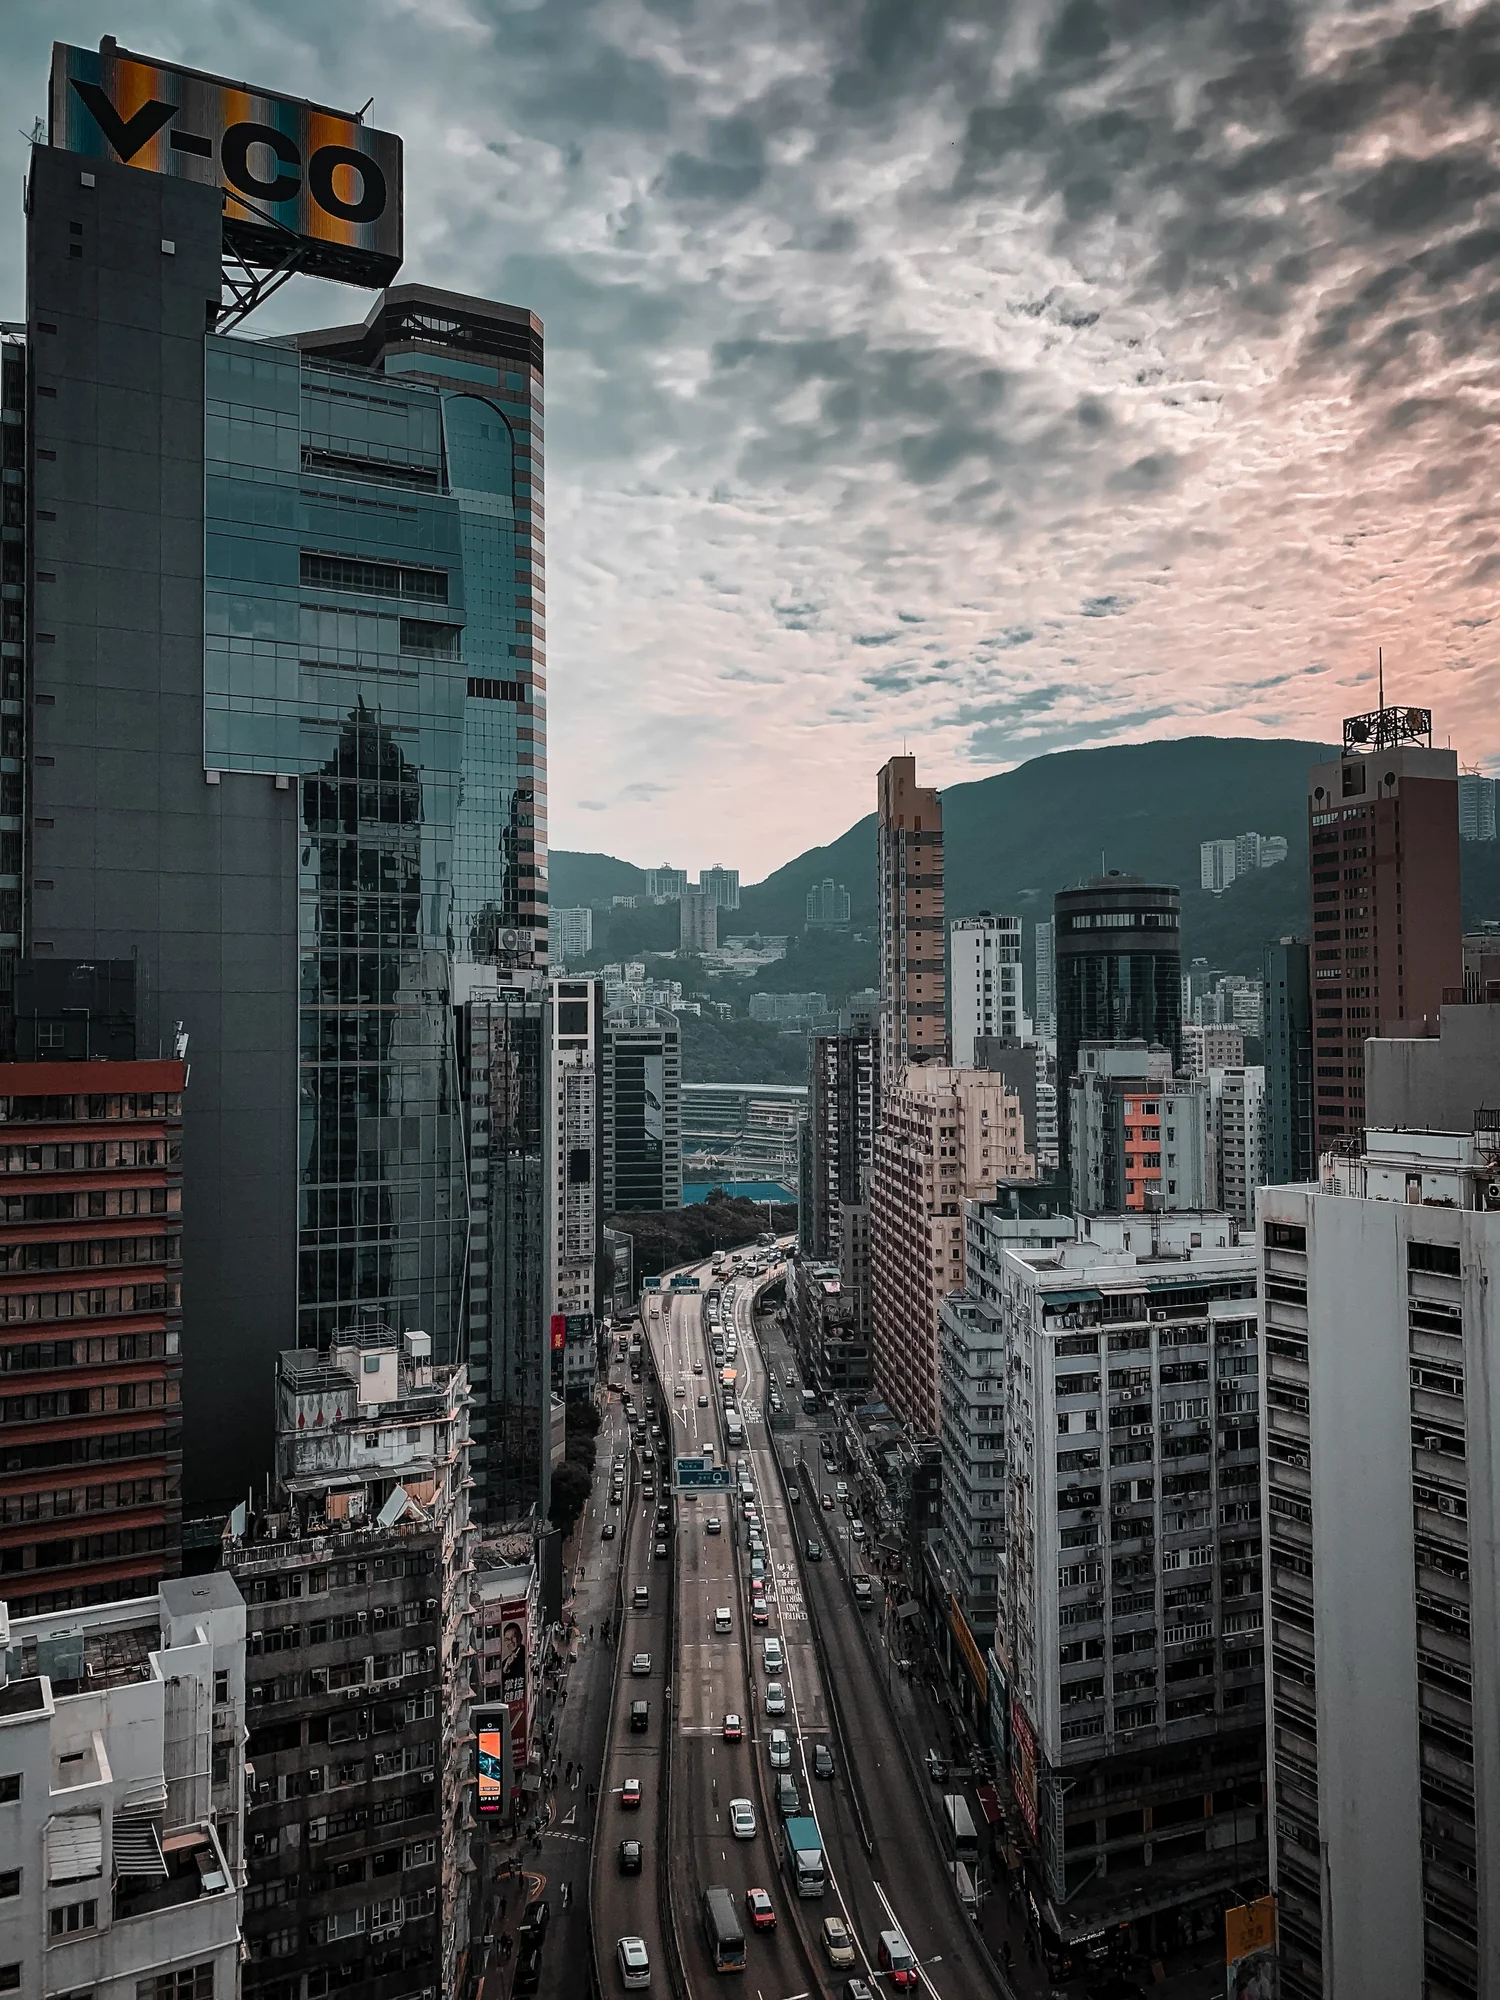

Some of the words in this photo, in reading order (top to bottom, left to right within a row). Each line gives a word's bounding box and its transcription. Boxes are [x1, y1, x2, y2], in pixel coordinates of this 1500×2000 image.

[68, 77, 387, 223] V-CO
[786, 1603, 800, 1612] AND
[504, 1689, 524, 1703] 健康
